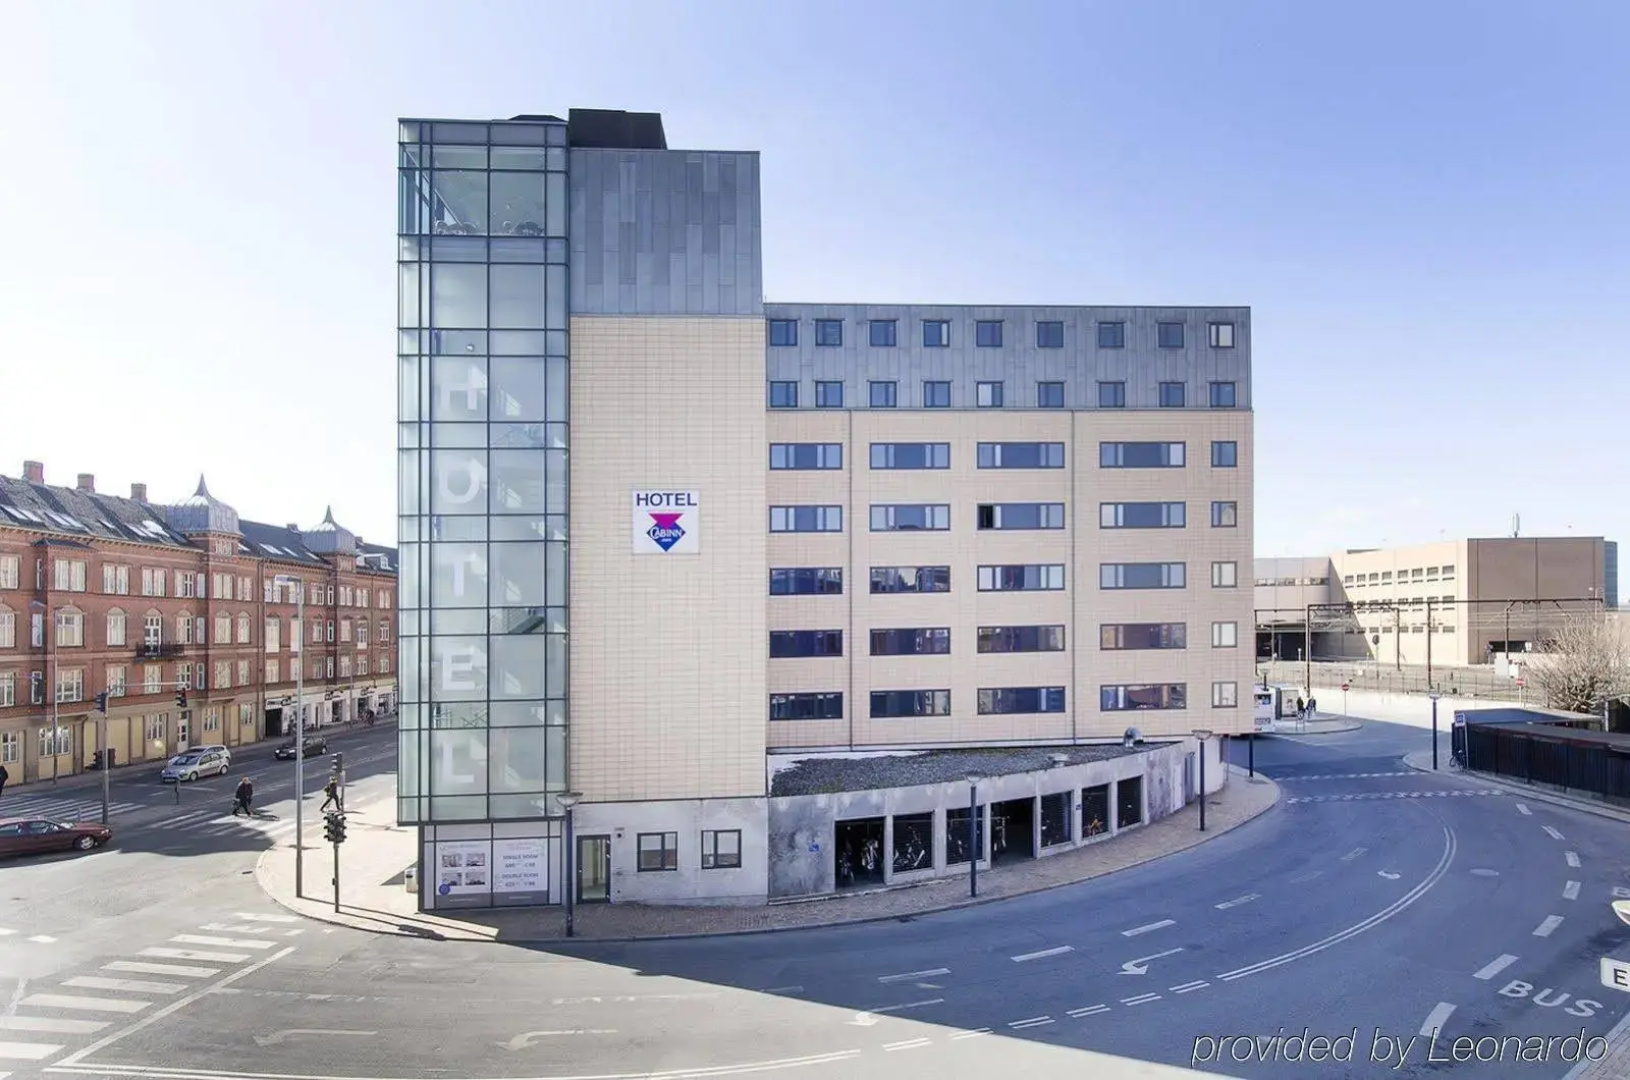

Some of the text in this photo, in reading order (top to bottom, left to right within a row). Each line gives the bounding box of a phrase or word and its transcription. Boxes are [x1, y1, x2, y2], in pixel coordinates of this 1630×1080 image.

[637, 493, 698, 506] HOTEL
[651, 527, 682, 539] CABINN
[1497, 979, 1604, 1018] BUS
